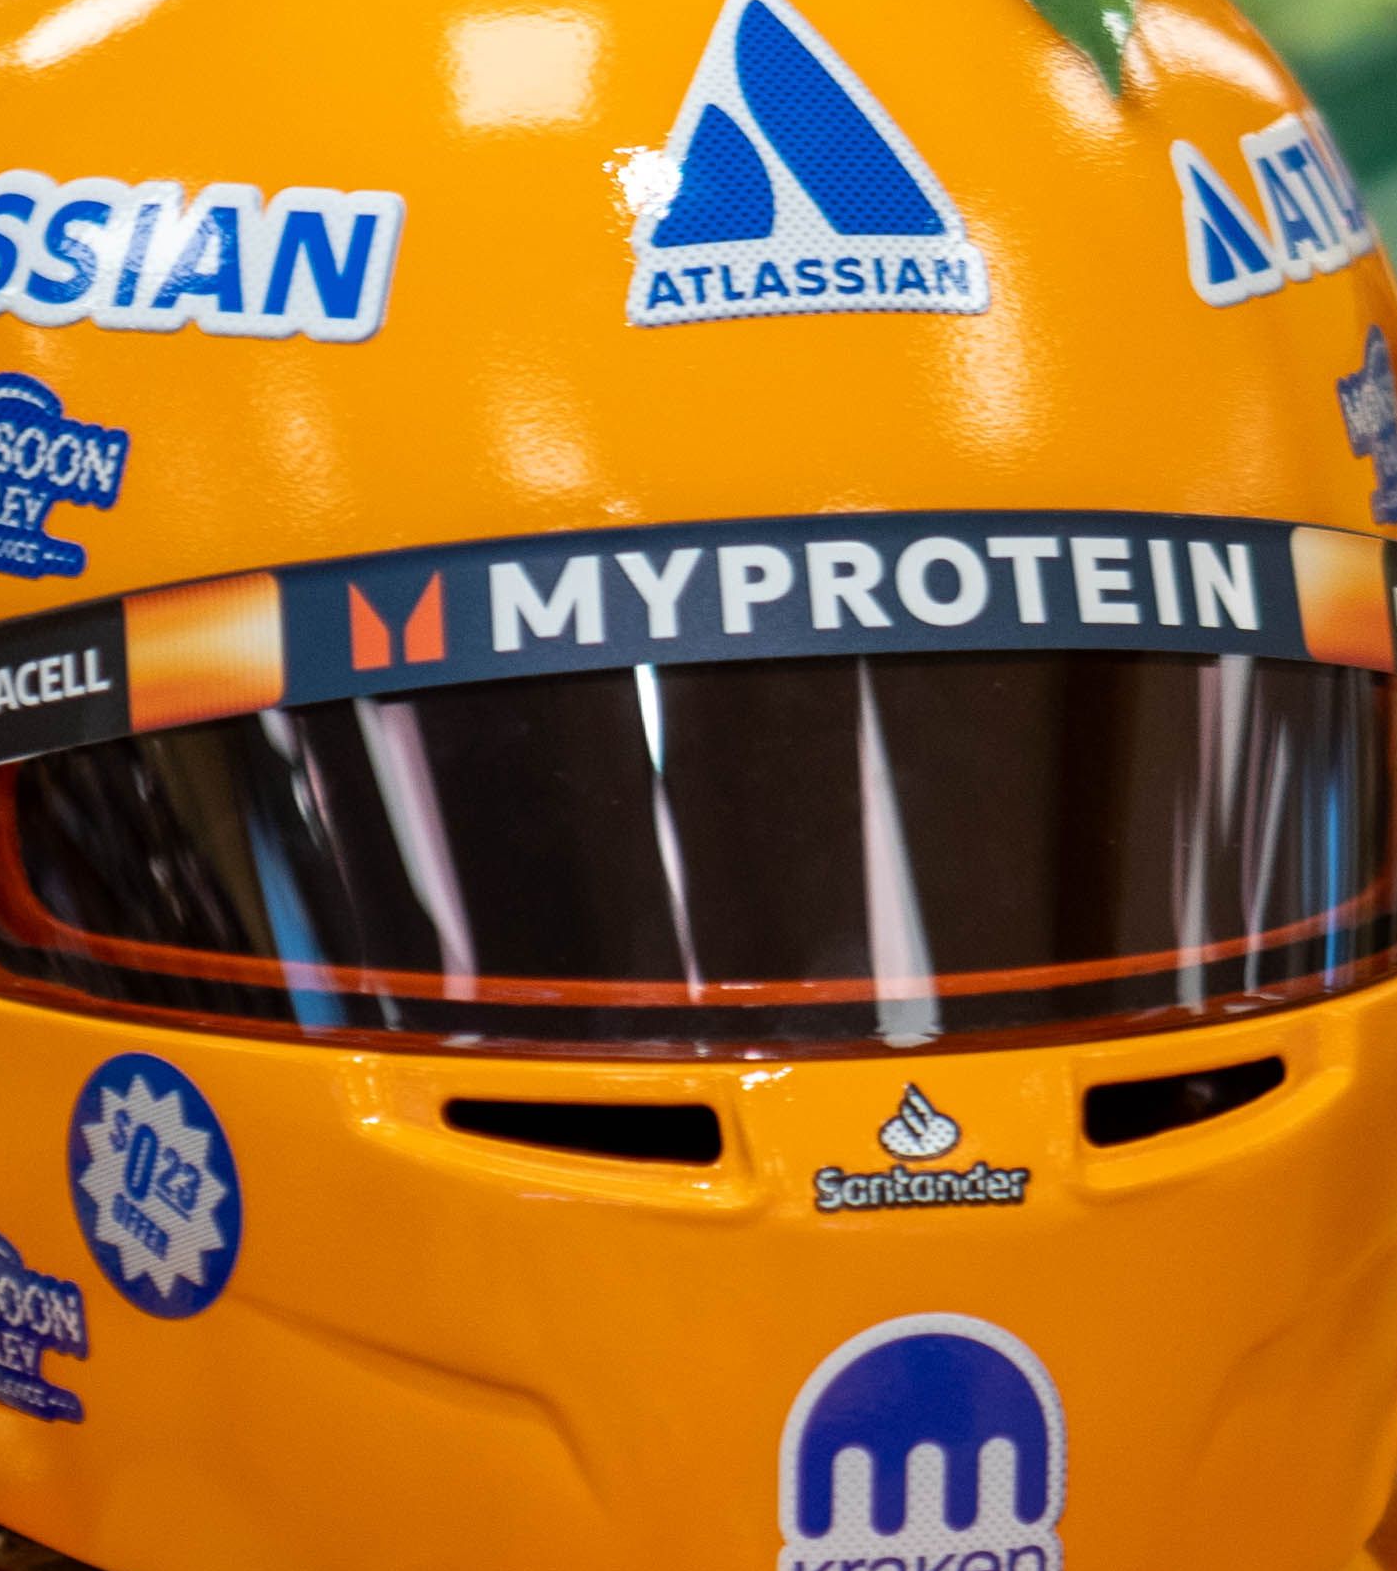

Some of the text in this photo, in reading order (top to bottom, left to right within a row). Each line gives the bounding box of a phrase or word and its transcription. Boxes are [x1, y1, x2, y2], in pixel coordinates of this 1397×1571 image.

[646, 257, 971, 310] ATLASSIAN
[488, 536, 1261, 653] MYPROTEIN
[816, 1163, 1030, 1212] Santander
[111, 1192, 171, 1262] OFFER
